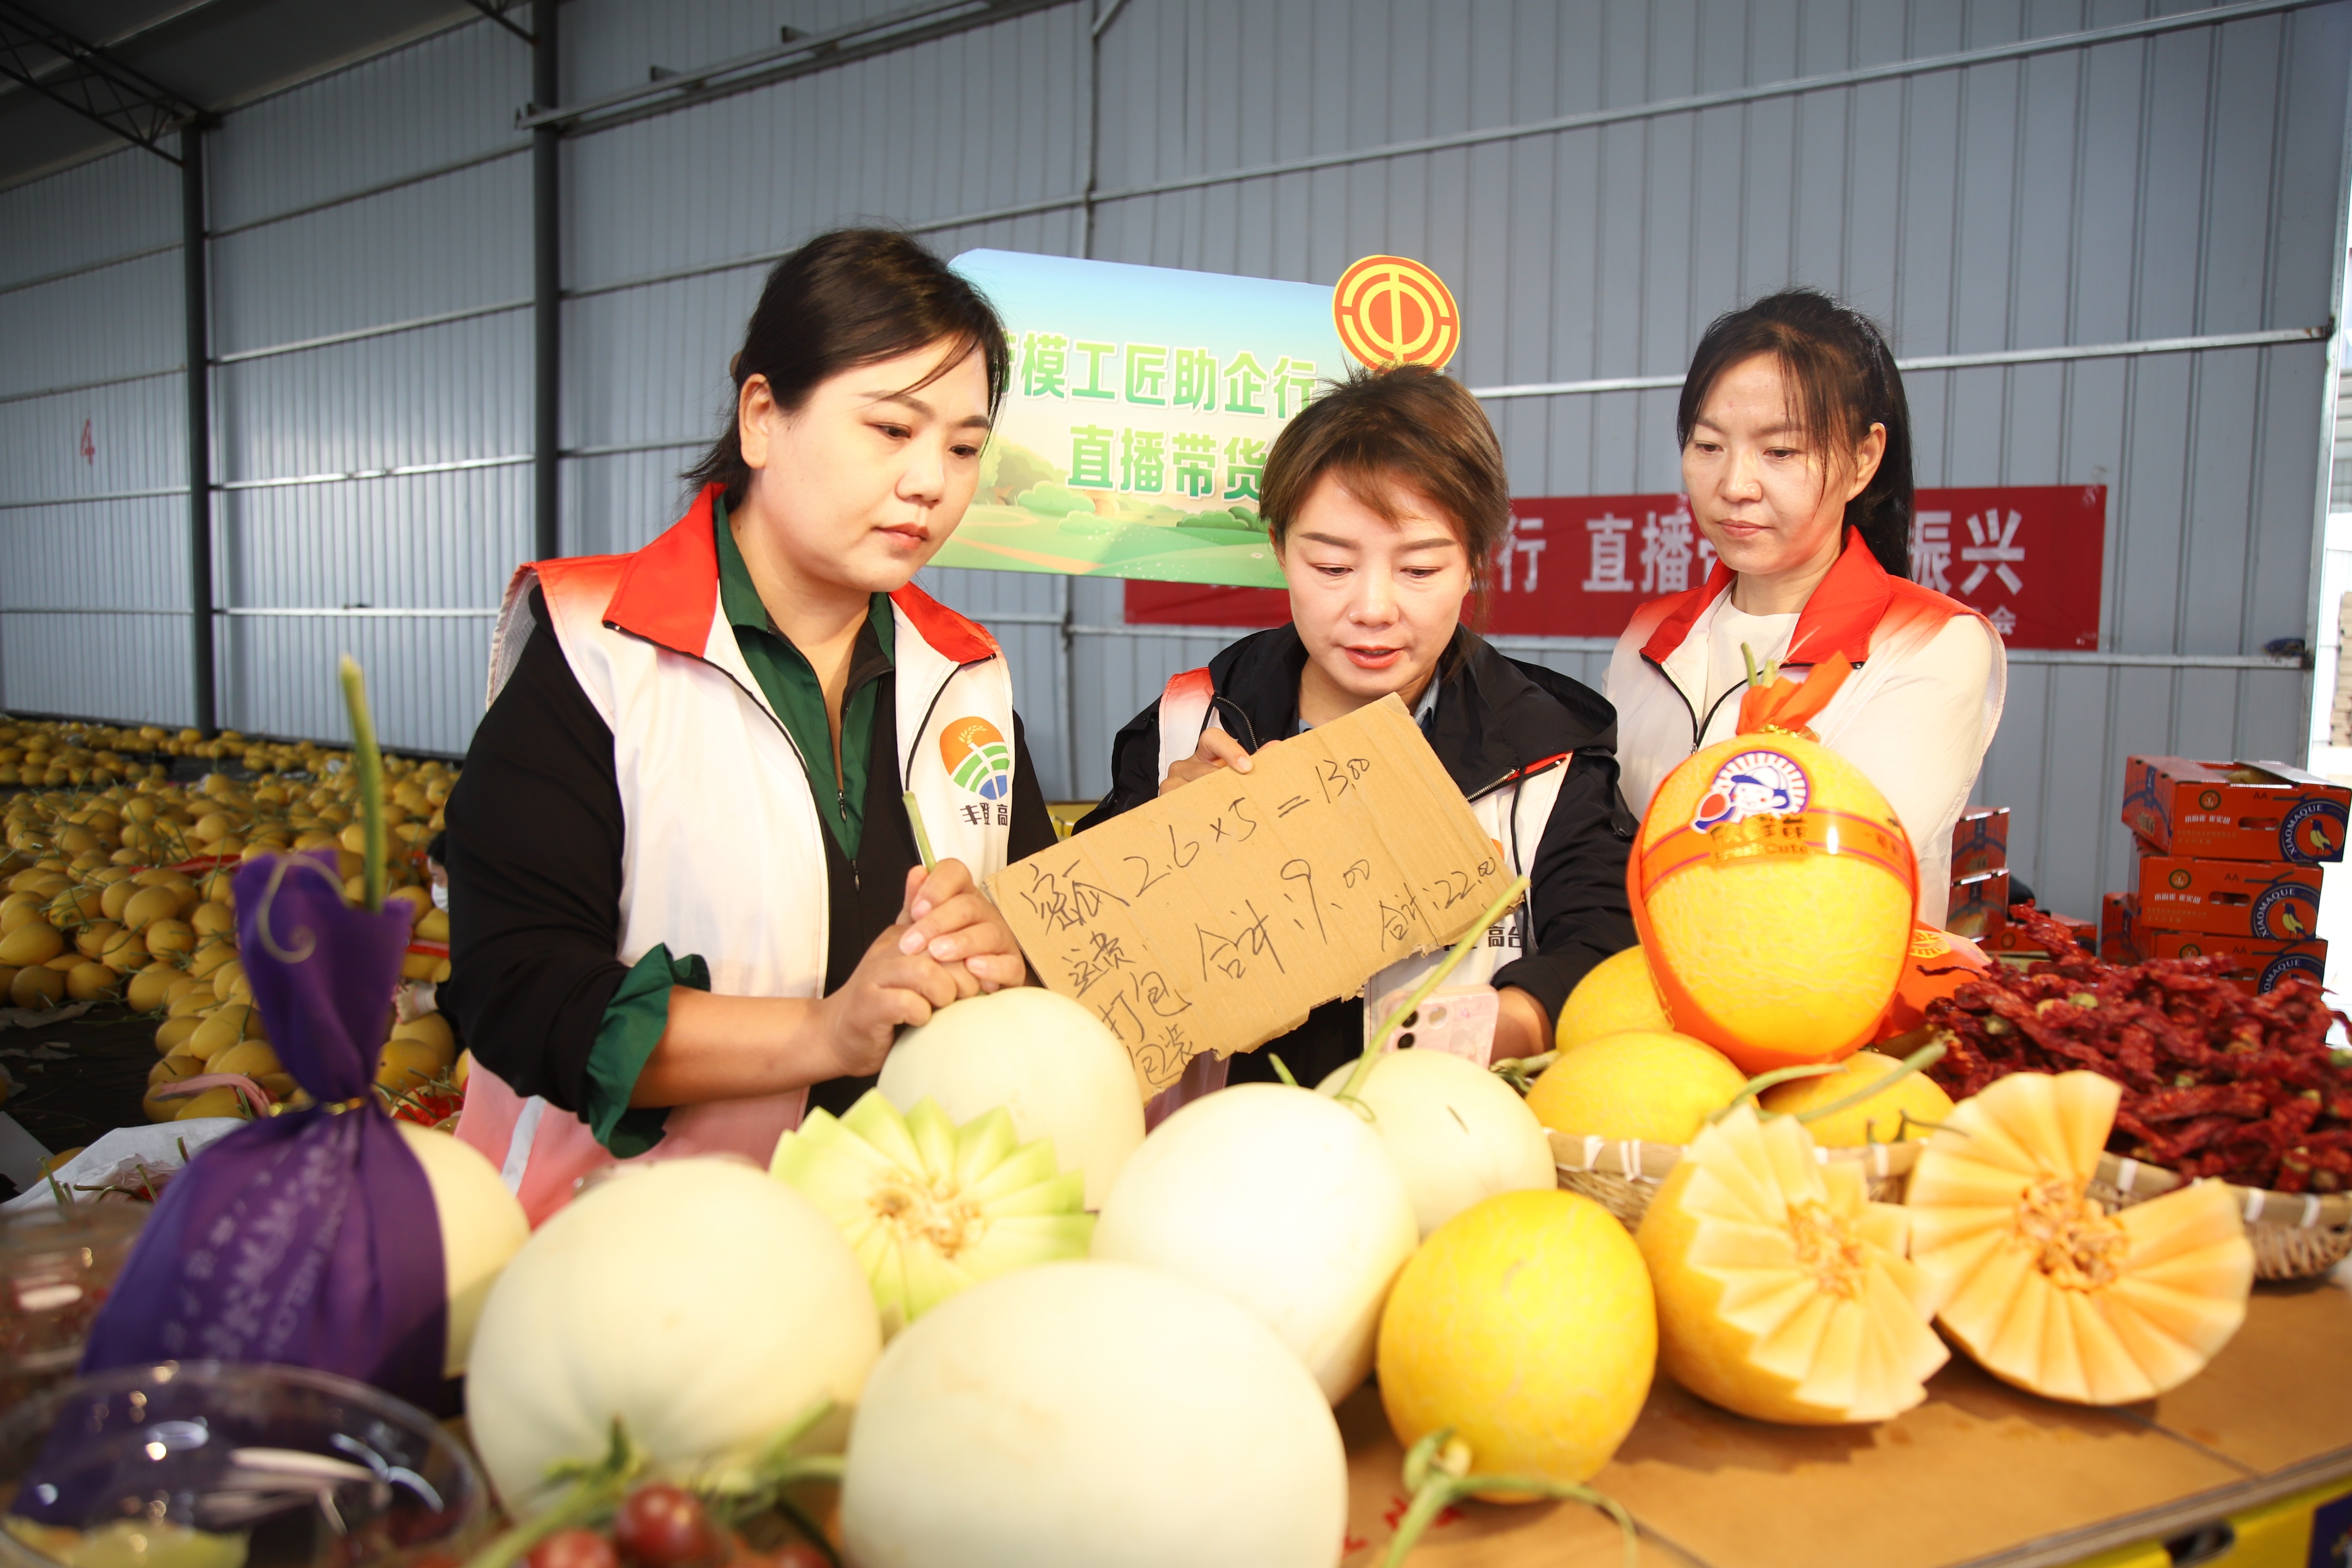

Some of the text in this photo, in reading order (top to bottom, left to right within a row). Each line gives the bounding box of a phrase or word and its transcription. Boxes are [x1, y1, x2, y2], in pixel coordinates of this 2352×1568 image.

[80, 418, 95, 466] 4
[1067, 424, 1267, 501] 直播带货
[1496, 515, 1547, 593] 行
[1909, 508, 2026, 596] 振兴
[2285, 804, 2323, 855] XIAOMAQUE
[2257, 887, 2295, 937] XIAOMAQUE
[2233, 946, 2247, 954] AA
[2264, 959, 2301, 994] OMAQUE
